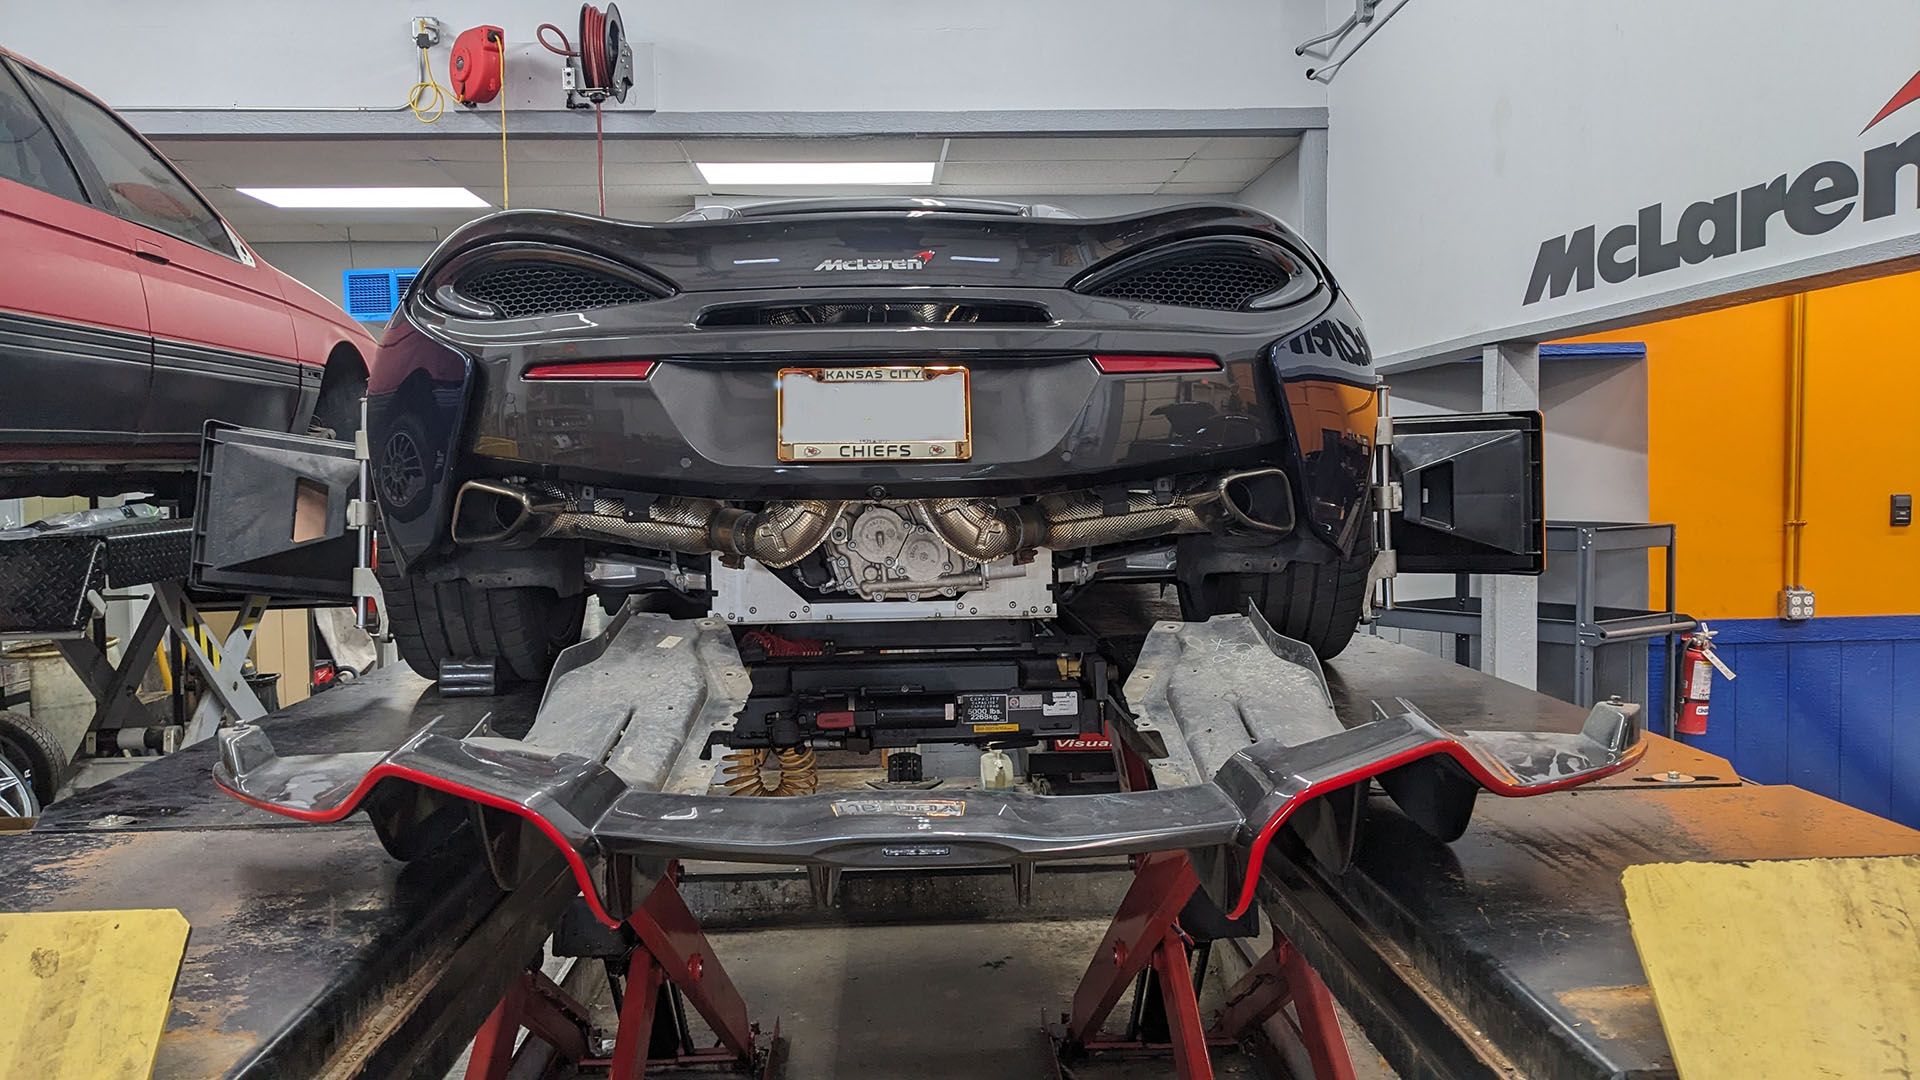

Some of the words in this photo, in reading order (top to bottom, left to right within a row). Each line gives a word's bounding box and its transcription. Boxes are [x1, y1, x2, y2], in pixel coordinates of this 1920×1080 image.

[1522, 131, 1920, 306] McLaren
[814, 259, 922, 271] McLaren
[826, 370, 883, 379] KANSAS
[890, 370, 921, 379] CITY
[839, 445, 911, 457] CHIEFS
[1056, 739, 1112, 747] Visua
